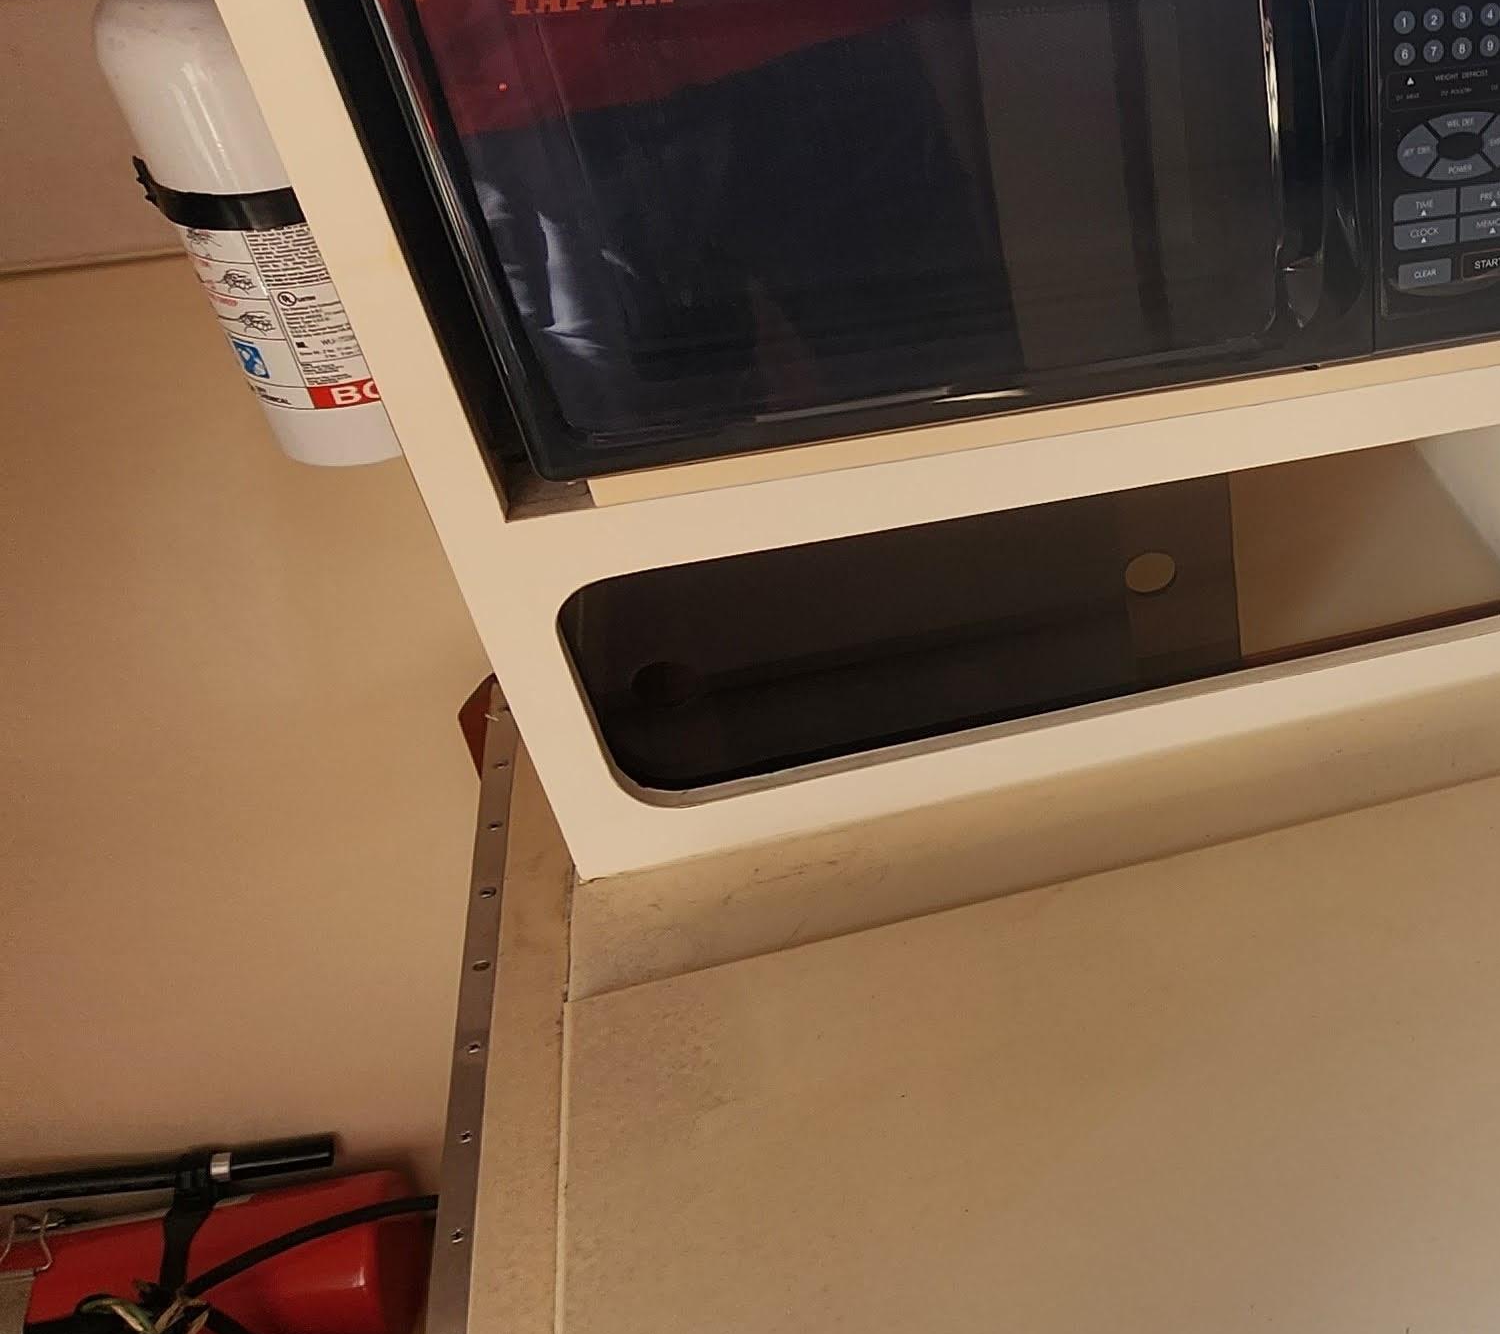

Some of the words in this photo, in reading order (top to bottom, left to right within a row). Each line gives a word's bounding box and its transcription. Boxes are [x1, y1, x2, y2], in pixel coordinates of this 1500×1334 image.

[1431, 15, 1438, 27] 2
[1459, 12, 1467, 23] 3
[1487, 9, 1493, 20] 4
[1401, 49, 1409, 60] 6
[1431, 46, 1437, 57] 7
[1459, 44, 1466, 54] 8
[1487, 40, 1494, 52] 9
[1415, 199, 1434, 209] TIME
[1410, 227, 1440, 238] CLOCK
[1414, 269, 1437, 279] CLEAR
